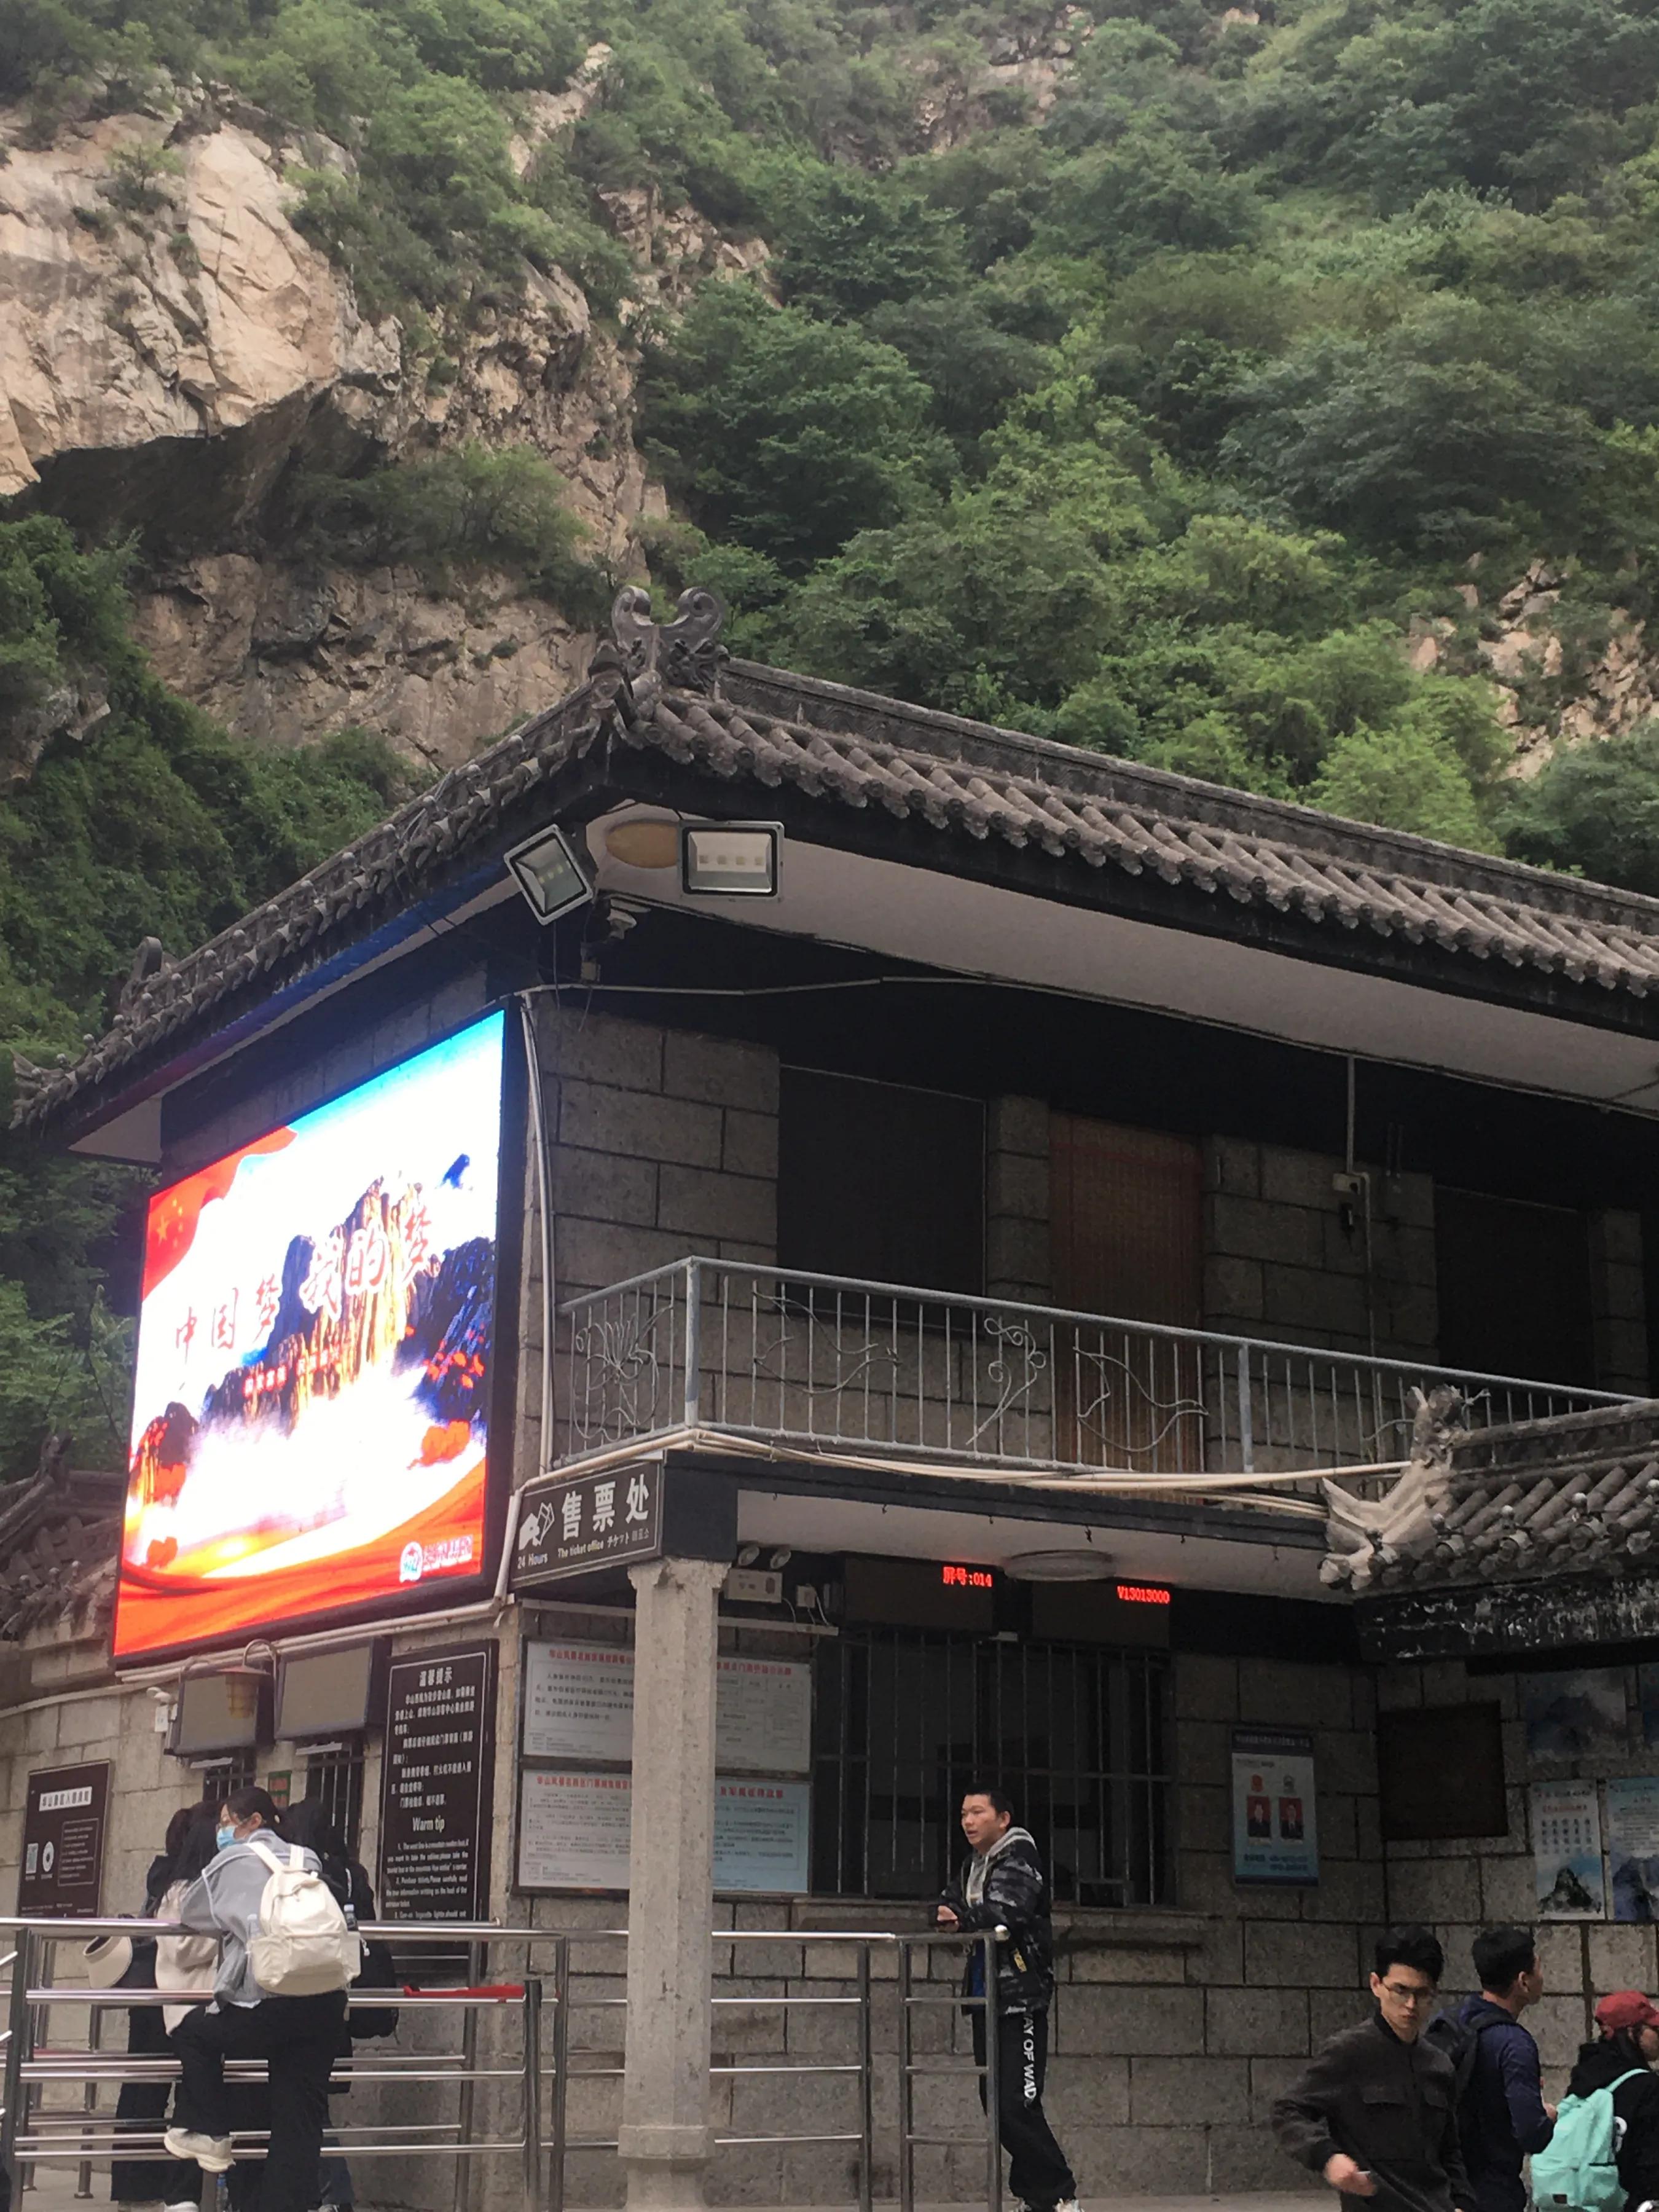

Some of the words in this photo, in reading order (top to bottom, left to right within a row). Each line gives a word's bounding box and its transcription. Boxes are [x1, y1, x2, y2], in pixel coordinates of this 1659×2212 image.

[176, 1273, 279, 1364] 中国梦
[304, 1206, 431, 1320] 我的梦
[562, 1473, 649, 1541] 售票处
[558, 1547, 568, 1559] The
[570, 1543, 586, 1556] ticket
[587, 1539, 604, 1553] office
[517, 1555, 526, 1569] 24
[528, 1553, 548, 1566] Hours
[412, 1816, 434, 1832] Warm
[434, 1814, 445, 1833] tip
[1023, 2013, 1034, 2036] AY
[1023, 2039, 1035, 2062] OF
[1023, 2063, 1037, 2109] WAD
